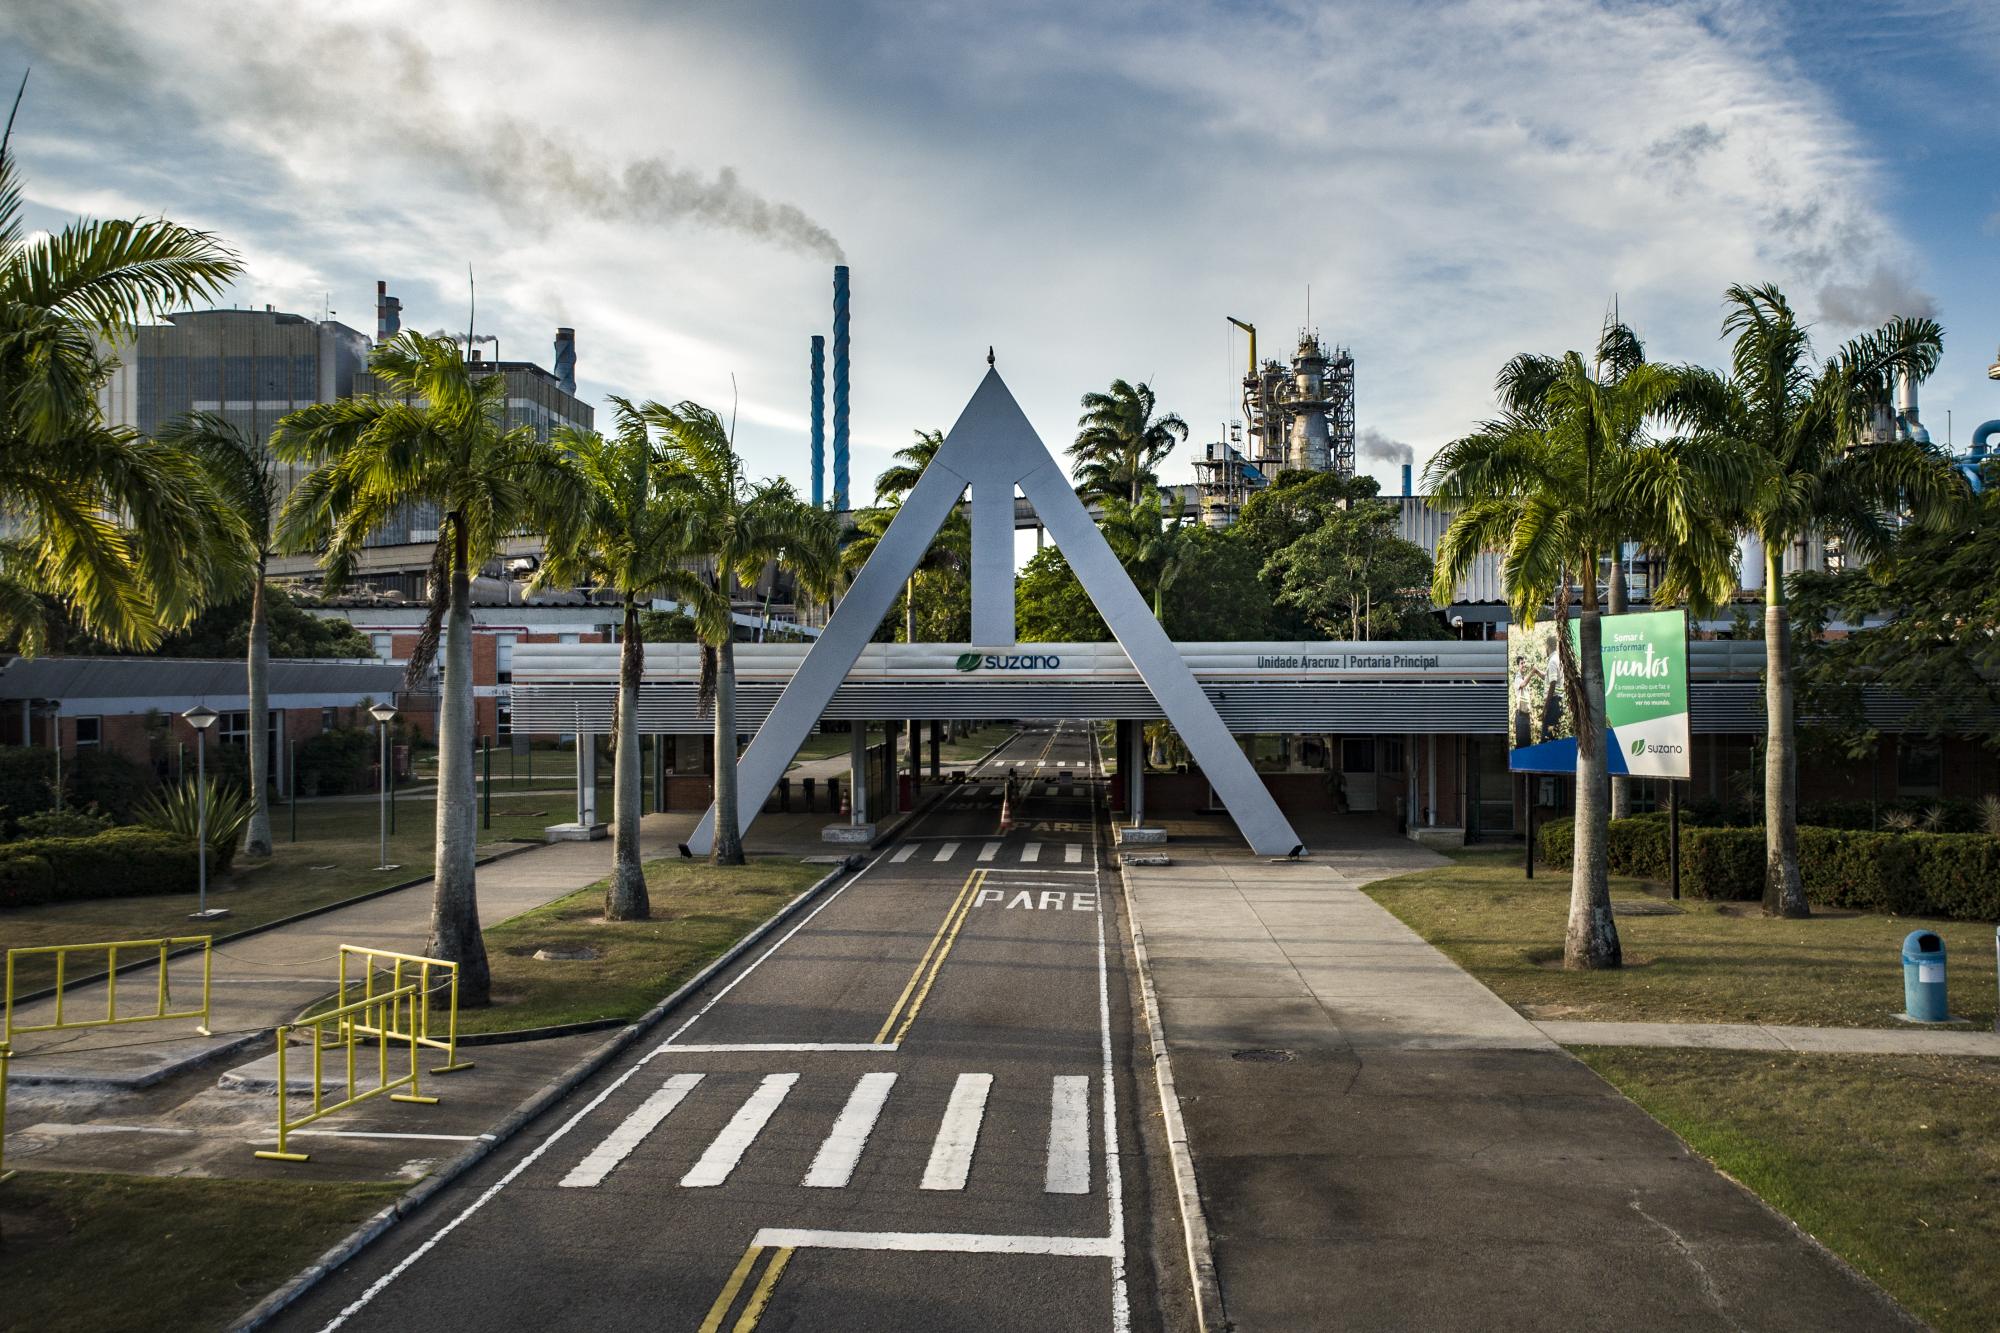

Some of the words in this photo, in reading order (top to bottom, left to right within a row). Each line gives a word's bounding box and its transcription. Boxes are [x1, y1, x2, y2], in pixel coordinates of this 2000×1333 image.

[1614, 633, 1637, 642] Somar
[1639, 632, 1644, 640] é
[985, 655, 1060, 670] suzano
[1257, 655, 1298, 668] Unidade
[1301, 655, 1340, 668] Aracruz
[1350, 655, 1391, 668] Portaria
[1393, 655, 1439, 671] Principal
[1605, 643, 1669, 697] juntos
[1647, 745, 1683, 754] suzano
[1011, 822, 1092, 832] PARE
[972, 889, 1096, 911] PARE
